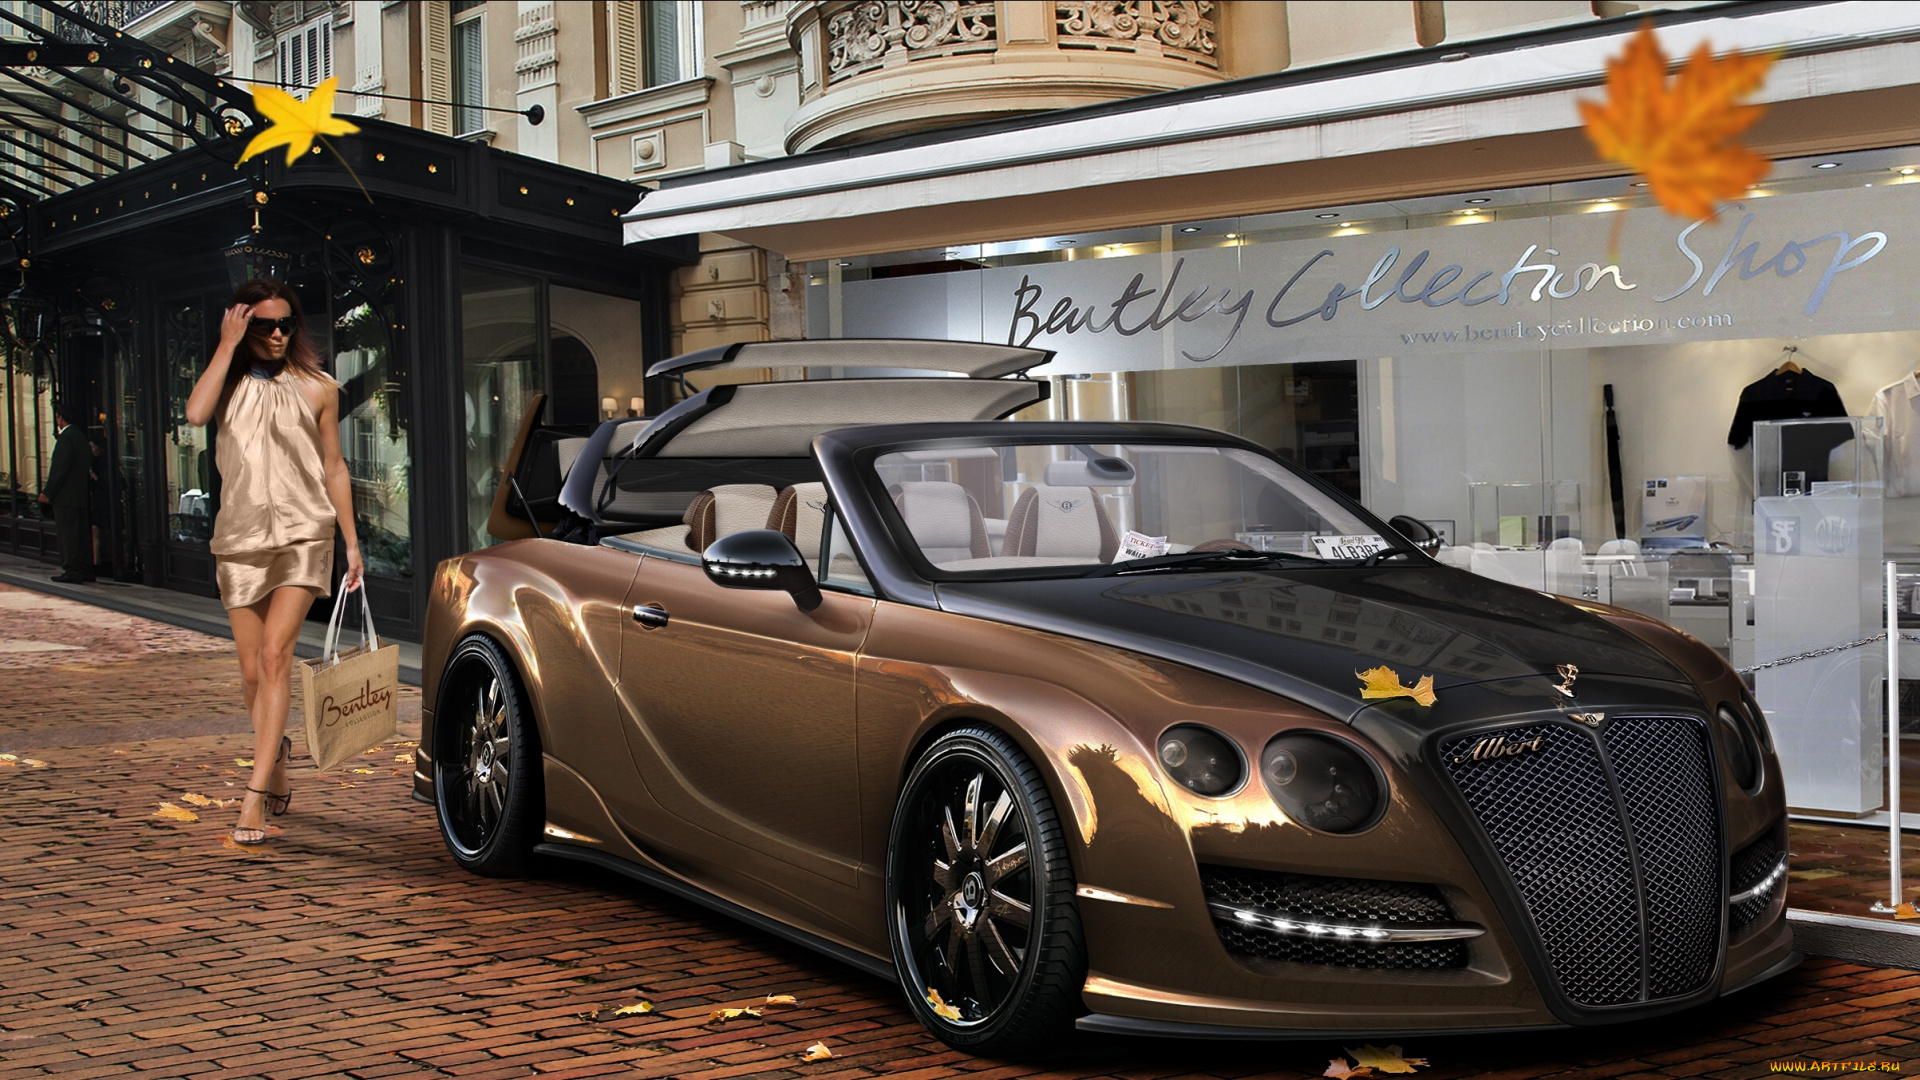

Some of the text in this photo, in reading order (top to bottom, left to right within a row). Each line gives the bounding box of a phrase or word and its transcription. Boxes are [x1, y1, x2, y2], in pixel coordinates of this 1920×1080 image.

[1009, 202, 1888, 362] Bentley Collection Shop
[1399, 310, 1734, 346] www.bentleycollection.com
[1130, 537, 1156, 549] TICKET
[317, 679, 392, 731] Bentley
[344, 709, 381, 728] COLLECTION
[1454, 736, 1545, 763] Albert
